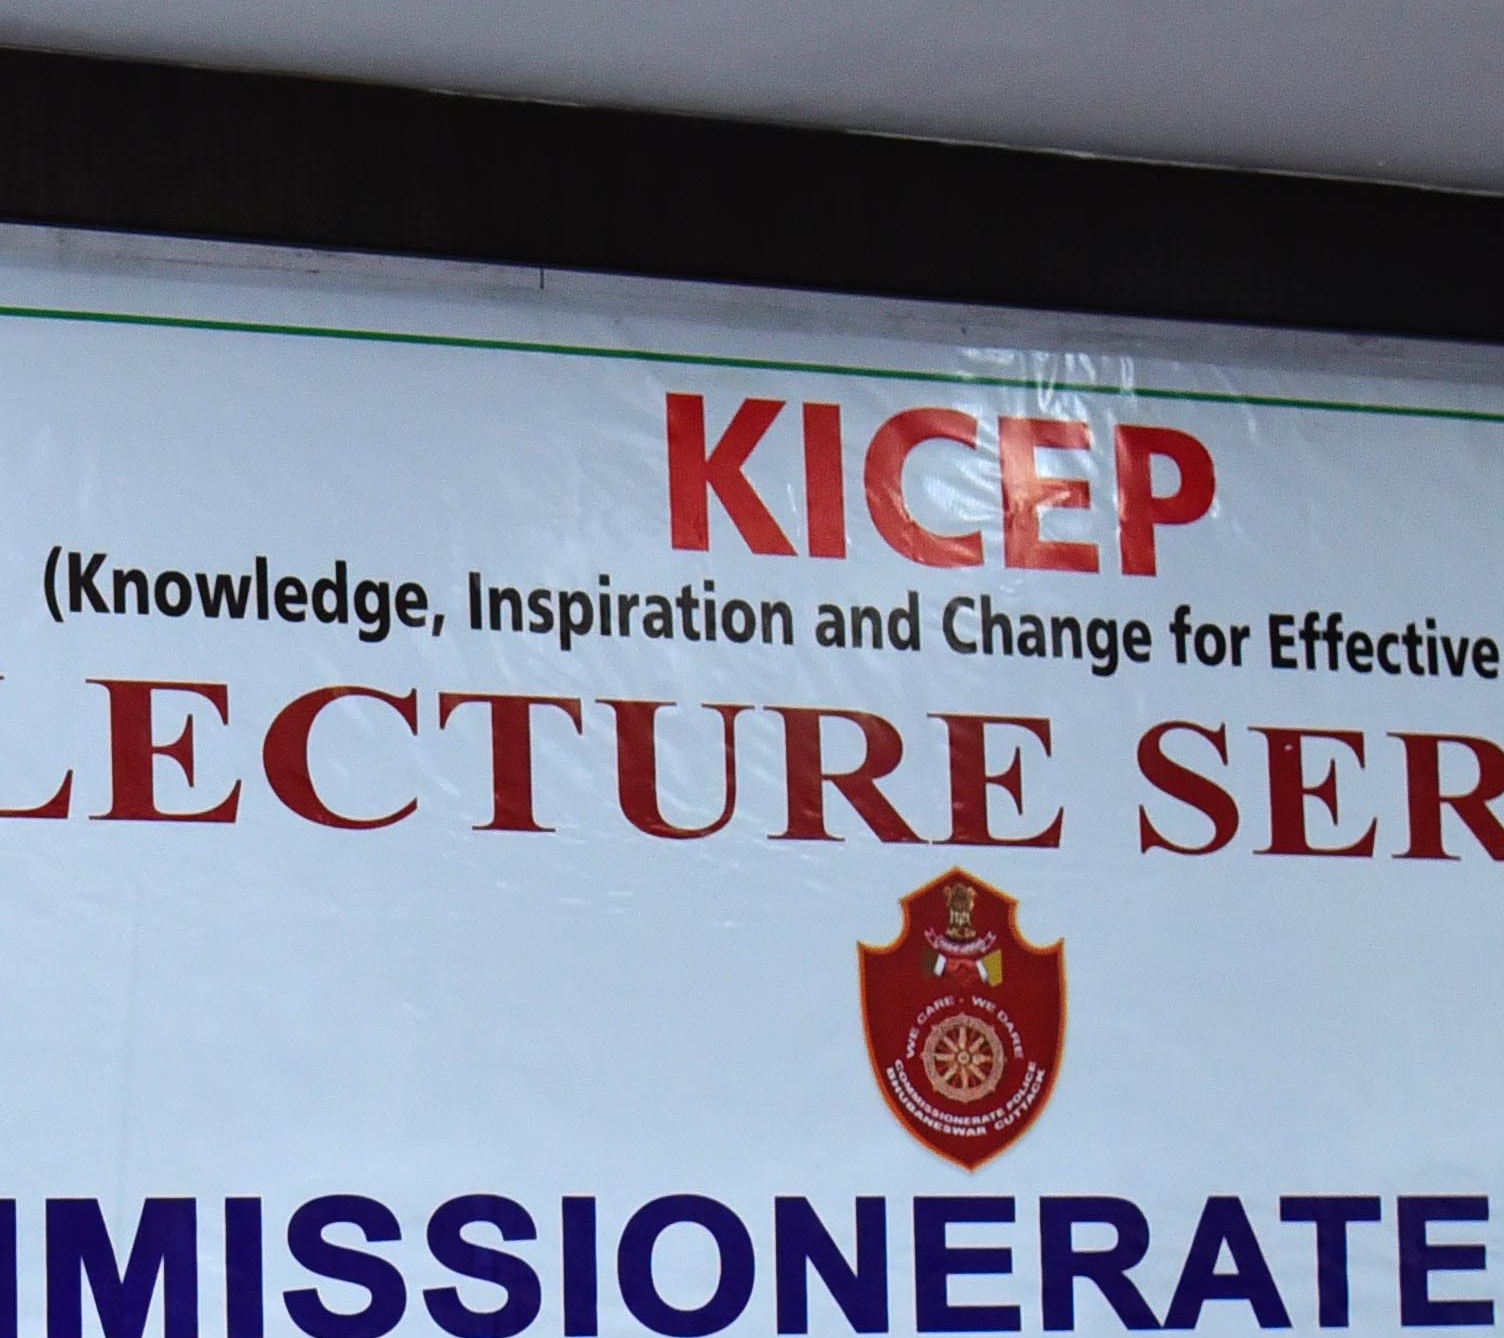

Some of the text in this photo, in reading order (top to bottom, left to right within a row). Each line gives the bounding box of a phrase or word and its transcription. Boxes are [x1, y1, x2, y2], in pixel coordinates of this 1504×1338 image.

[666, 391, 1216, 577] KICEP
[43, 545, 446, 643] (Knowledge,
[468, 570, 794, 652] Inspiration
[814, 591, 922, 652] and
[941, 595, 1153, 677] Change
[1168, 604, 1252, 668] for
[1267, 611, 1501, 680] Effective
[917, 995, 955, 1025] CARE
[972, 994, 996, 1013] WE
[997, 1010, 1024, 1060] DARE
[886, 1066, 1046, 1137] BHUBANESWAR CUTTACK
[894, 1059, 1037, 1126] COMMISSIONERATE POLICE
